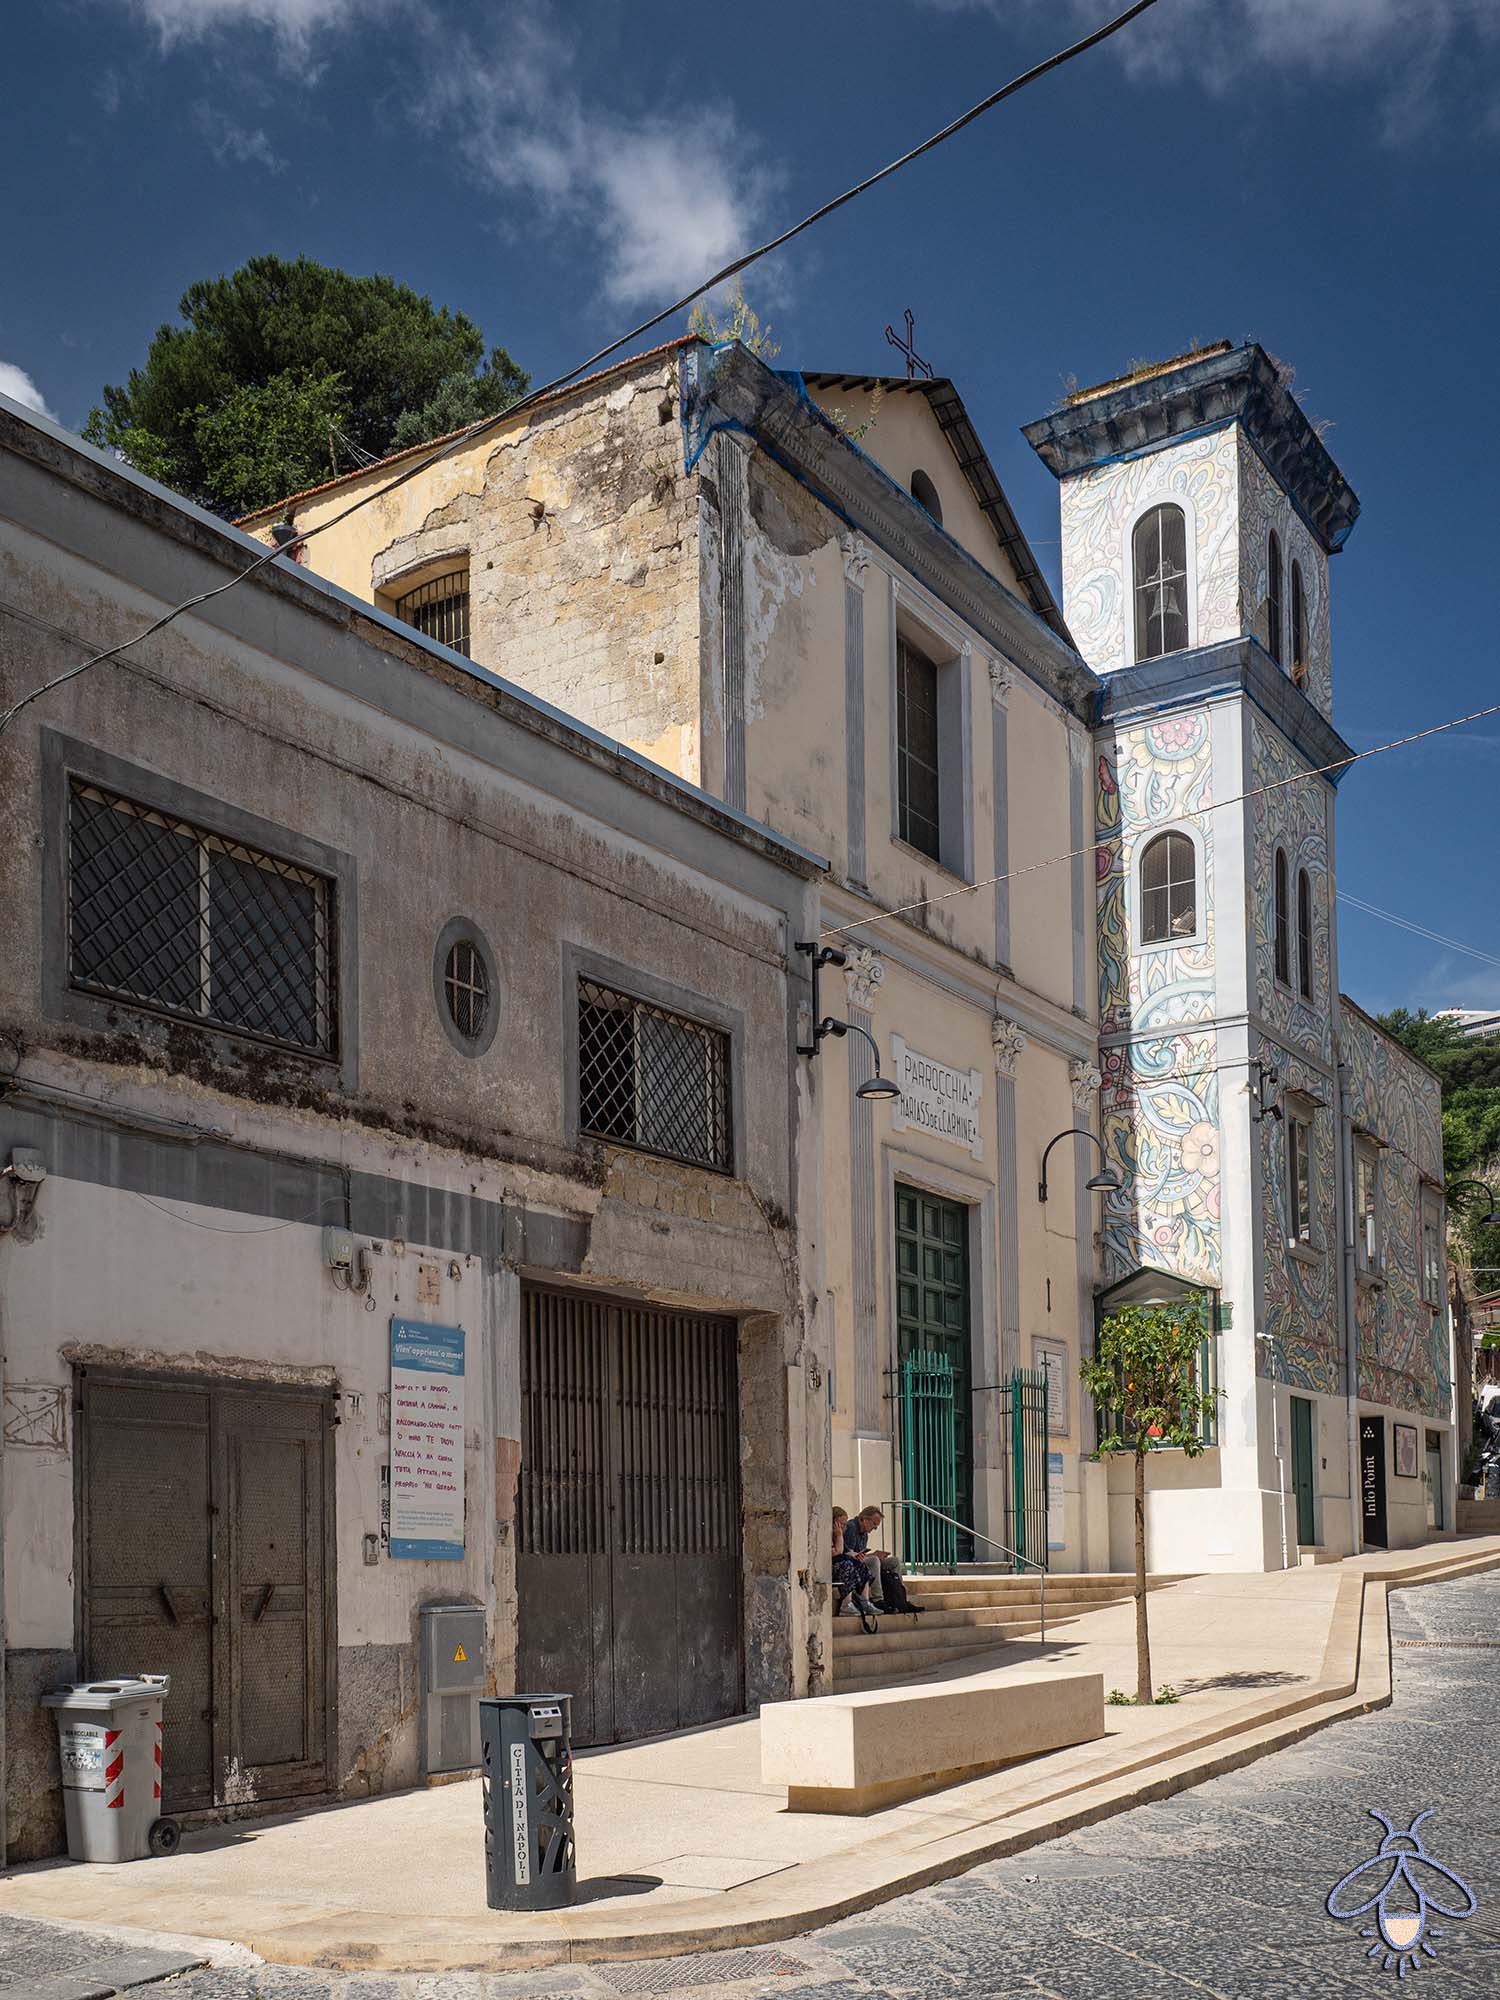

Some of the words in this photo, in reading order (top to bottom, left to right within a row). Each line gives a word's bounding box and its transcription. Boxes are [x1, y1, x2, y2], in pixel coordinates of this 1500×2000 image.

[905, 1055, 969, 1105] PARROCCHIA
[426, 1434, 435, 1444] TE
[1363, 1455, 1376, 1489] Point
[1364, 1491, 1376, 1517] Info
[515, 1800, 524, 1819] DI
[516, 1823, 527, 1879] NAPOLI
